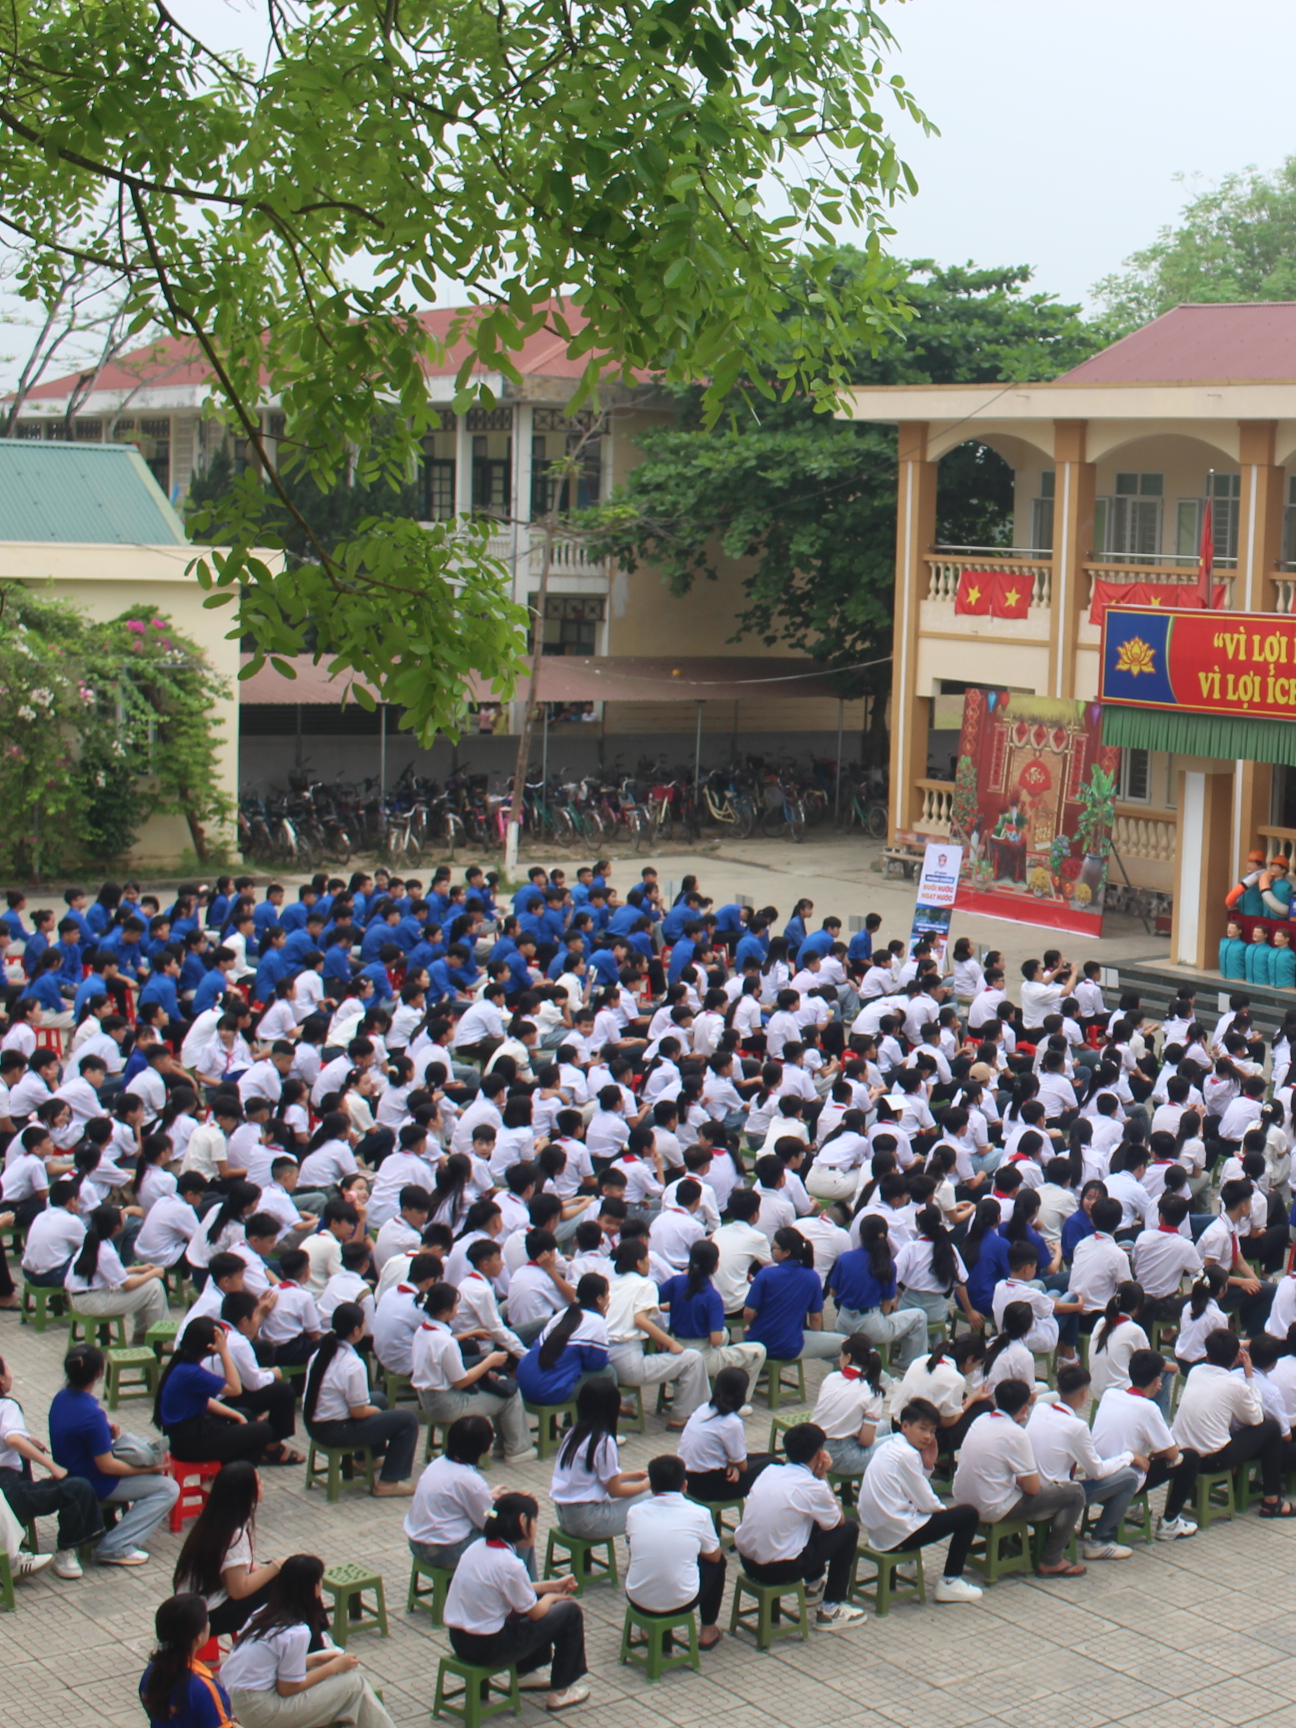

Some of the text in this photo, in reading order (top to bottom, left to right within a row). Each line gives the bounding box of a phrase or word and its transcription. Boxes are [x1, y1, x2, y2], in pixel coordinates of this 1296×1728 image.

[1213, 626, 1247, 660] “VÌ
[1252, 631, 1288, 669] LỢI
[1198, 665, 1221, 699] VÌ
[1226, 670, 1261, 709] LỢI
